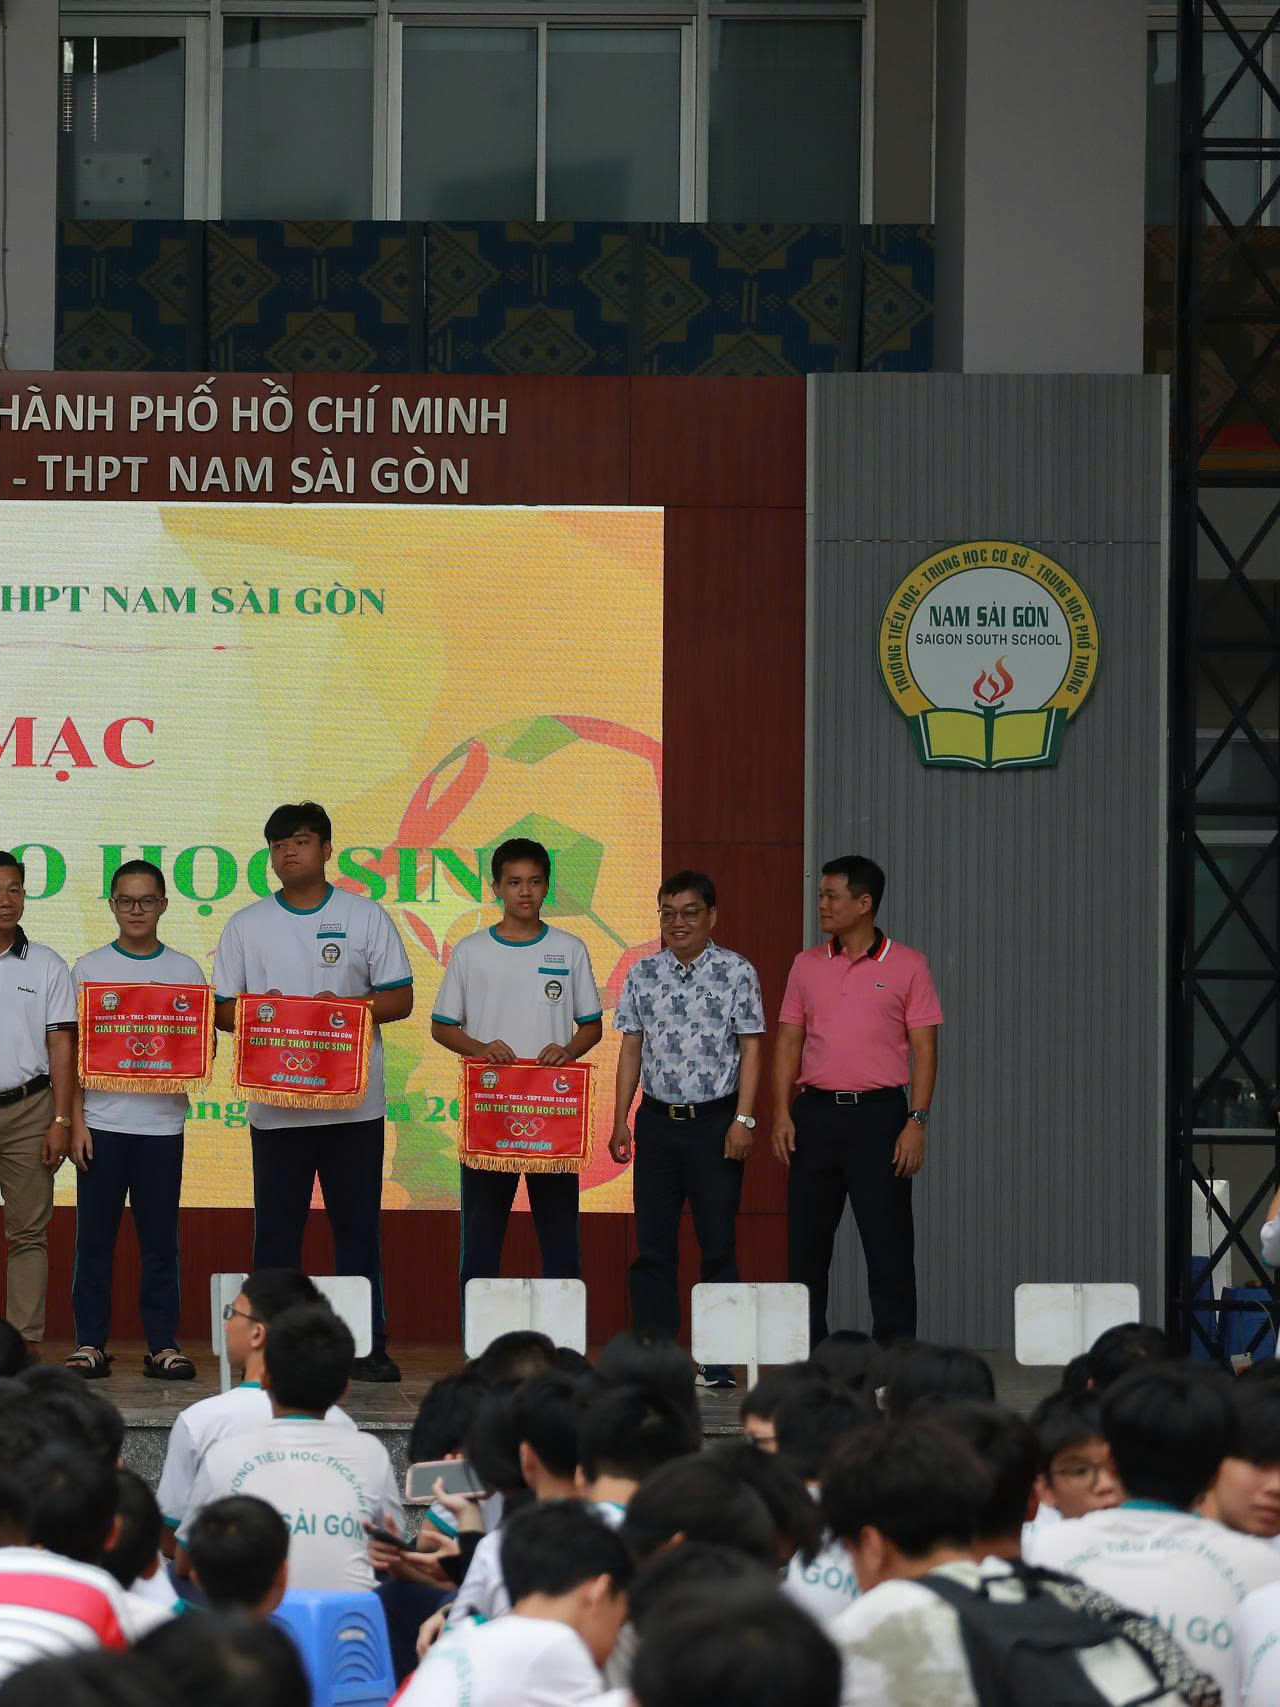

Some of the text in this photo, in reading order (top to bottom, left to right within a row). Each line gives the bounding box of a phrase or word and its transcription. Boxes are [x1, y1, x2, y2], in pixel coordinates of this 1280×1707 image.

[130, 376, 218, 432] PHỐ
[232, 378, 293, 433] HỒ
[307, 384, 381, 434] CHÍ
[392, 397, 507, 434] MINH
[37, 455, 148, 493] THPT
[169, 456, 273, 493] NAM
[290, 447, 356, 494] SÀI
[370, 446, 468, 495] GÒN
[921, 554, 961, 584] TRUNG
[962, 549, 987, 566] HỌC
[992, 549, 1009, 563] CƠ
[1012, 550, 1030, 568] SỞ
[1036, 563, 1072, 599] TRUNG
[102, 587, 197, 615] NAM
[211, 580, 280, 616] SÀI
[295, 582, 386, 616] GÒN
[898, 584, 921, 611] HỌC
[1065, 596, 1086, 622] HỌC
[885, 611, 907, 640] TIỂU
[929, 601, 1049, 627] NAM SÀI GÒN
[915, 633, 1062, 647] SAIGON SOUTH SCHOOL
[1075, 624, 1096, 651] PHỔ
[1066, 654, 1090, 695] THÔNG
[134, 1025, 154, 1033] THAO
[176, 1026, 196, 1034] SINH
[288, 1039, 310, 1048] THAO
[332, 1042, 352, 1051] SINH
[512, 1105, 534, 1113] THAO
[557, 1107, 576, 1115] SINH
